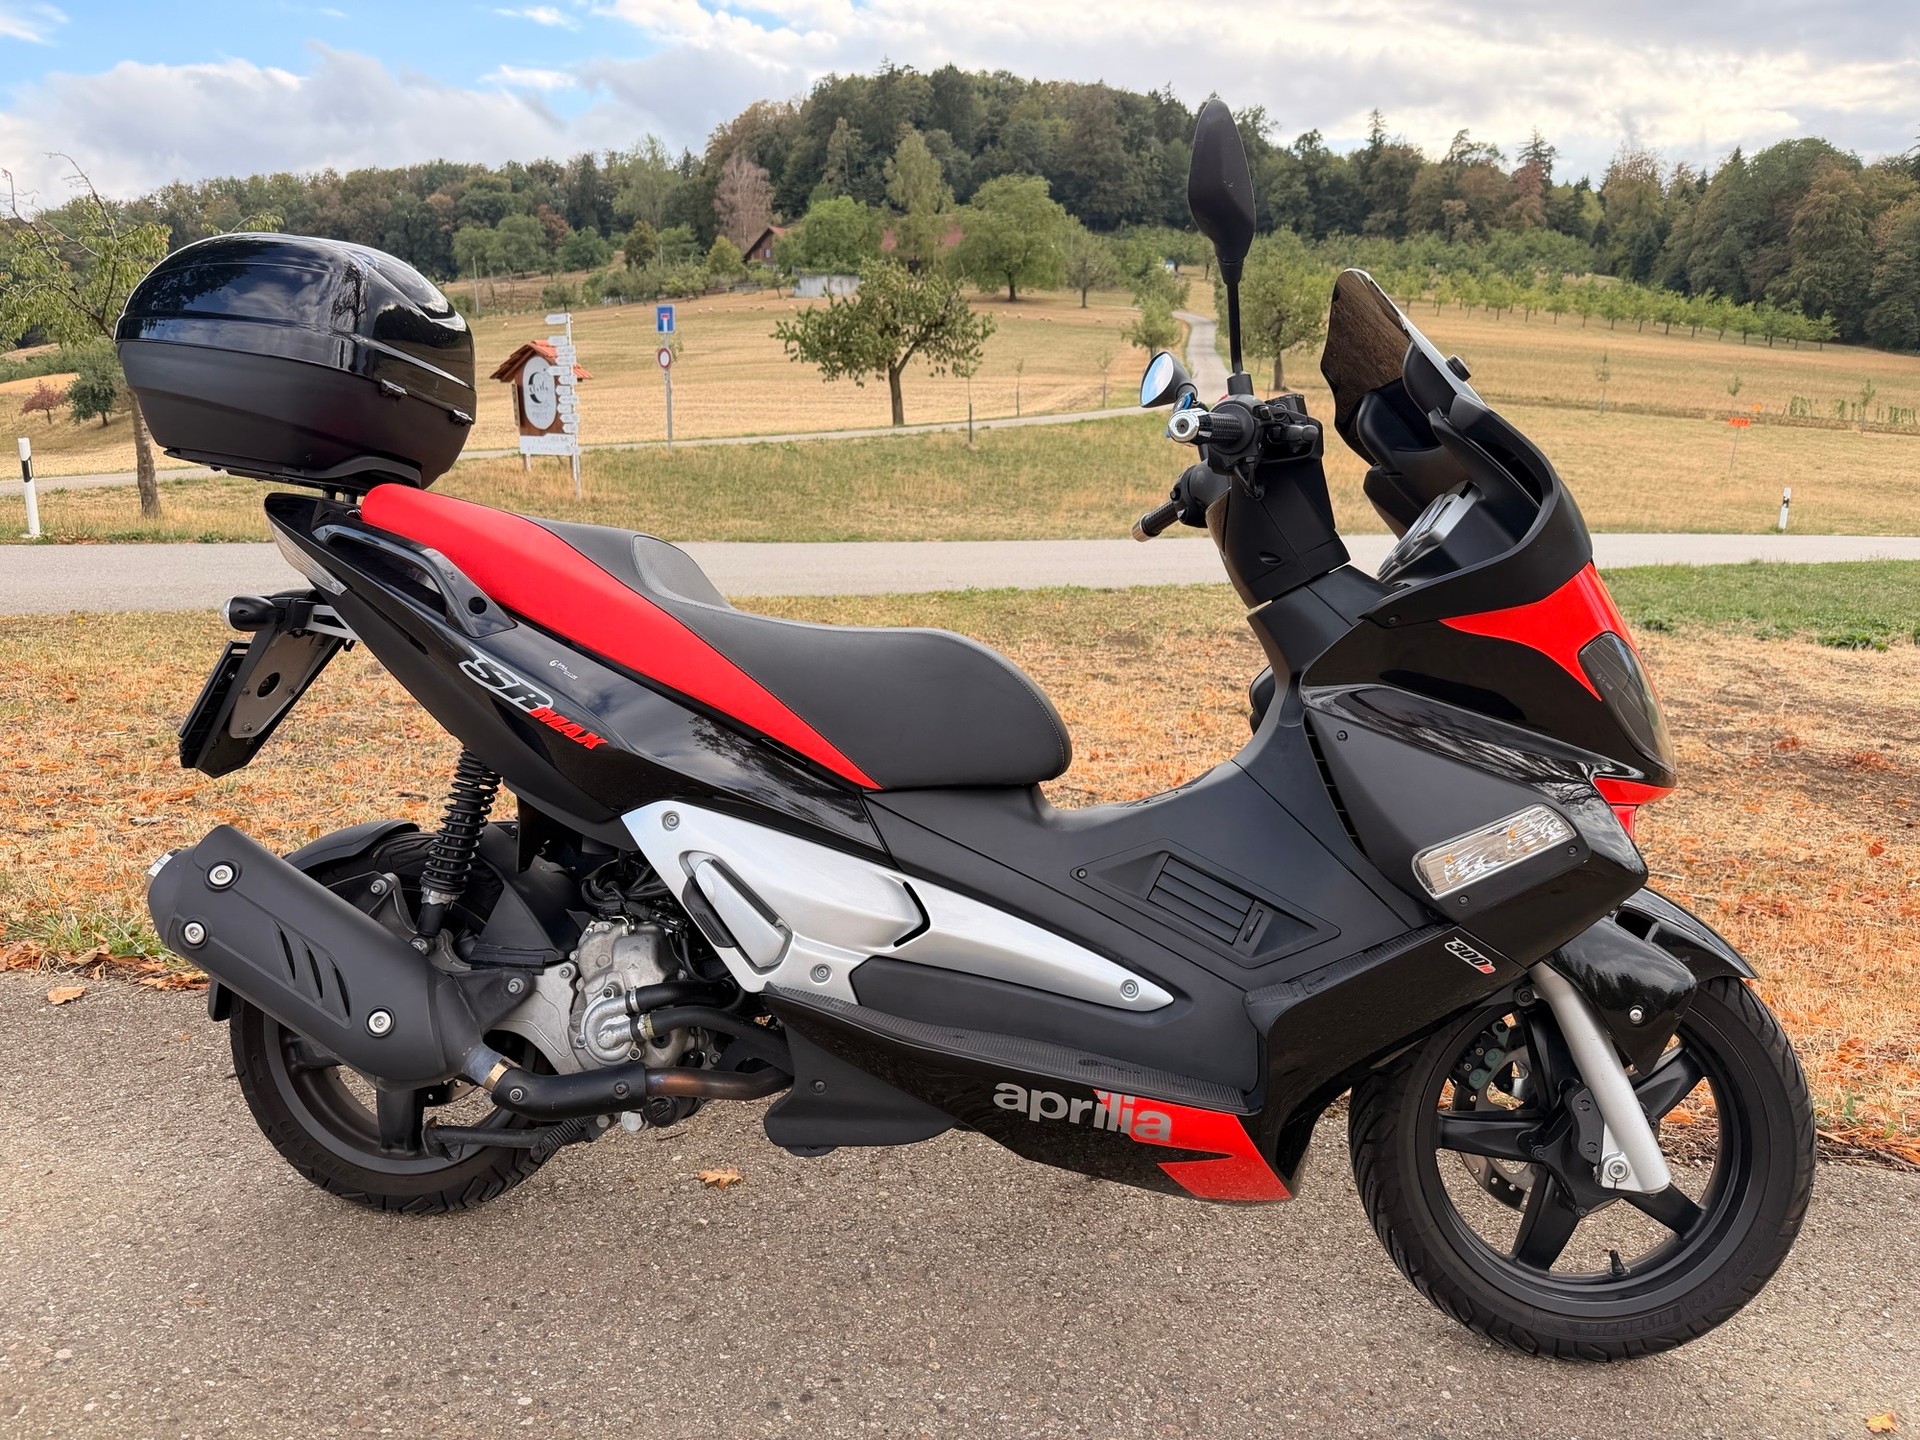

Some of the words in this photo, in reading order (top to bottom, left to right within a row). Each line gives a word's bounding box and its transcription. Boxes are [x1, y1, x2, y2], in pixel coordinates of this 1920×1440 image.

[458, 645, 554, 712] SR
[528, 706, 608, 750] MAX
[993, 1082, 1172, 1142] aprilia
[1578, 1307, 1675, 1336] MICHELIN
